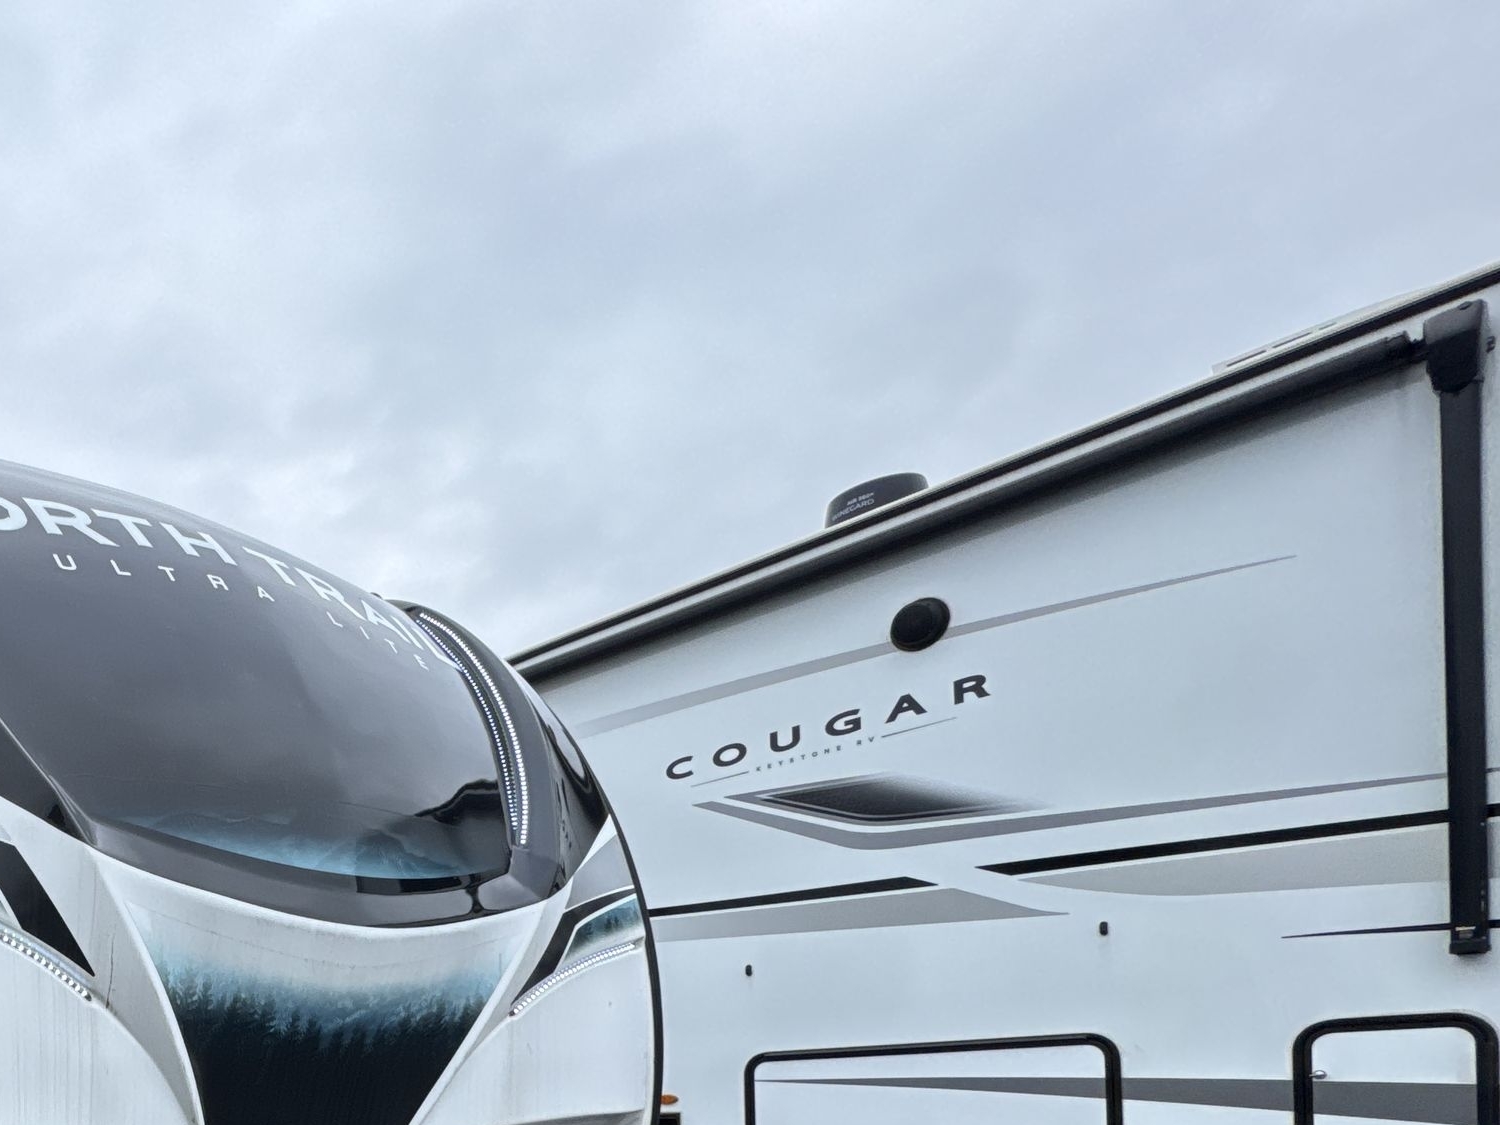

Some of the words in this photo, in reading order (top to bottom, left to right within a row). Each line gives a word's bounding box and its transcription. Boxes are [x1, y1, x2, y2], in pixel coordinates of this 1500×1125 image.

[52, 552, 276, 603] ULTRA
[325, 610, 430, 672] LITE
[241, 546, 463, 672] TRAIL
[665, 673, 992, 781] COUGAR
[755, 745, 842, 772] KEYSTONE
[856, 736, 875, 746] RV
